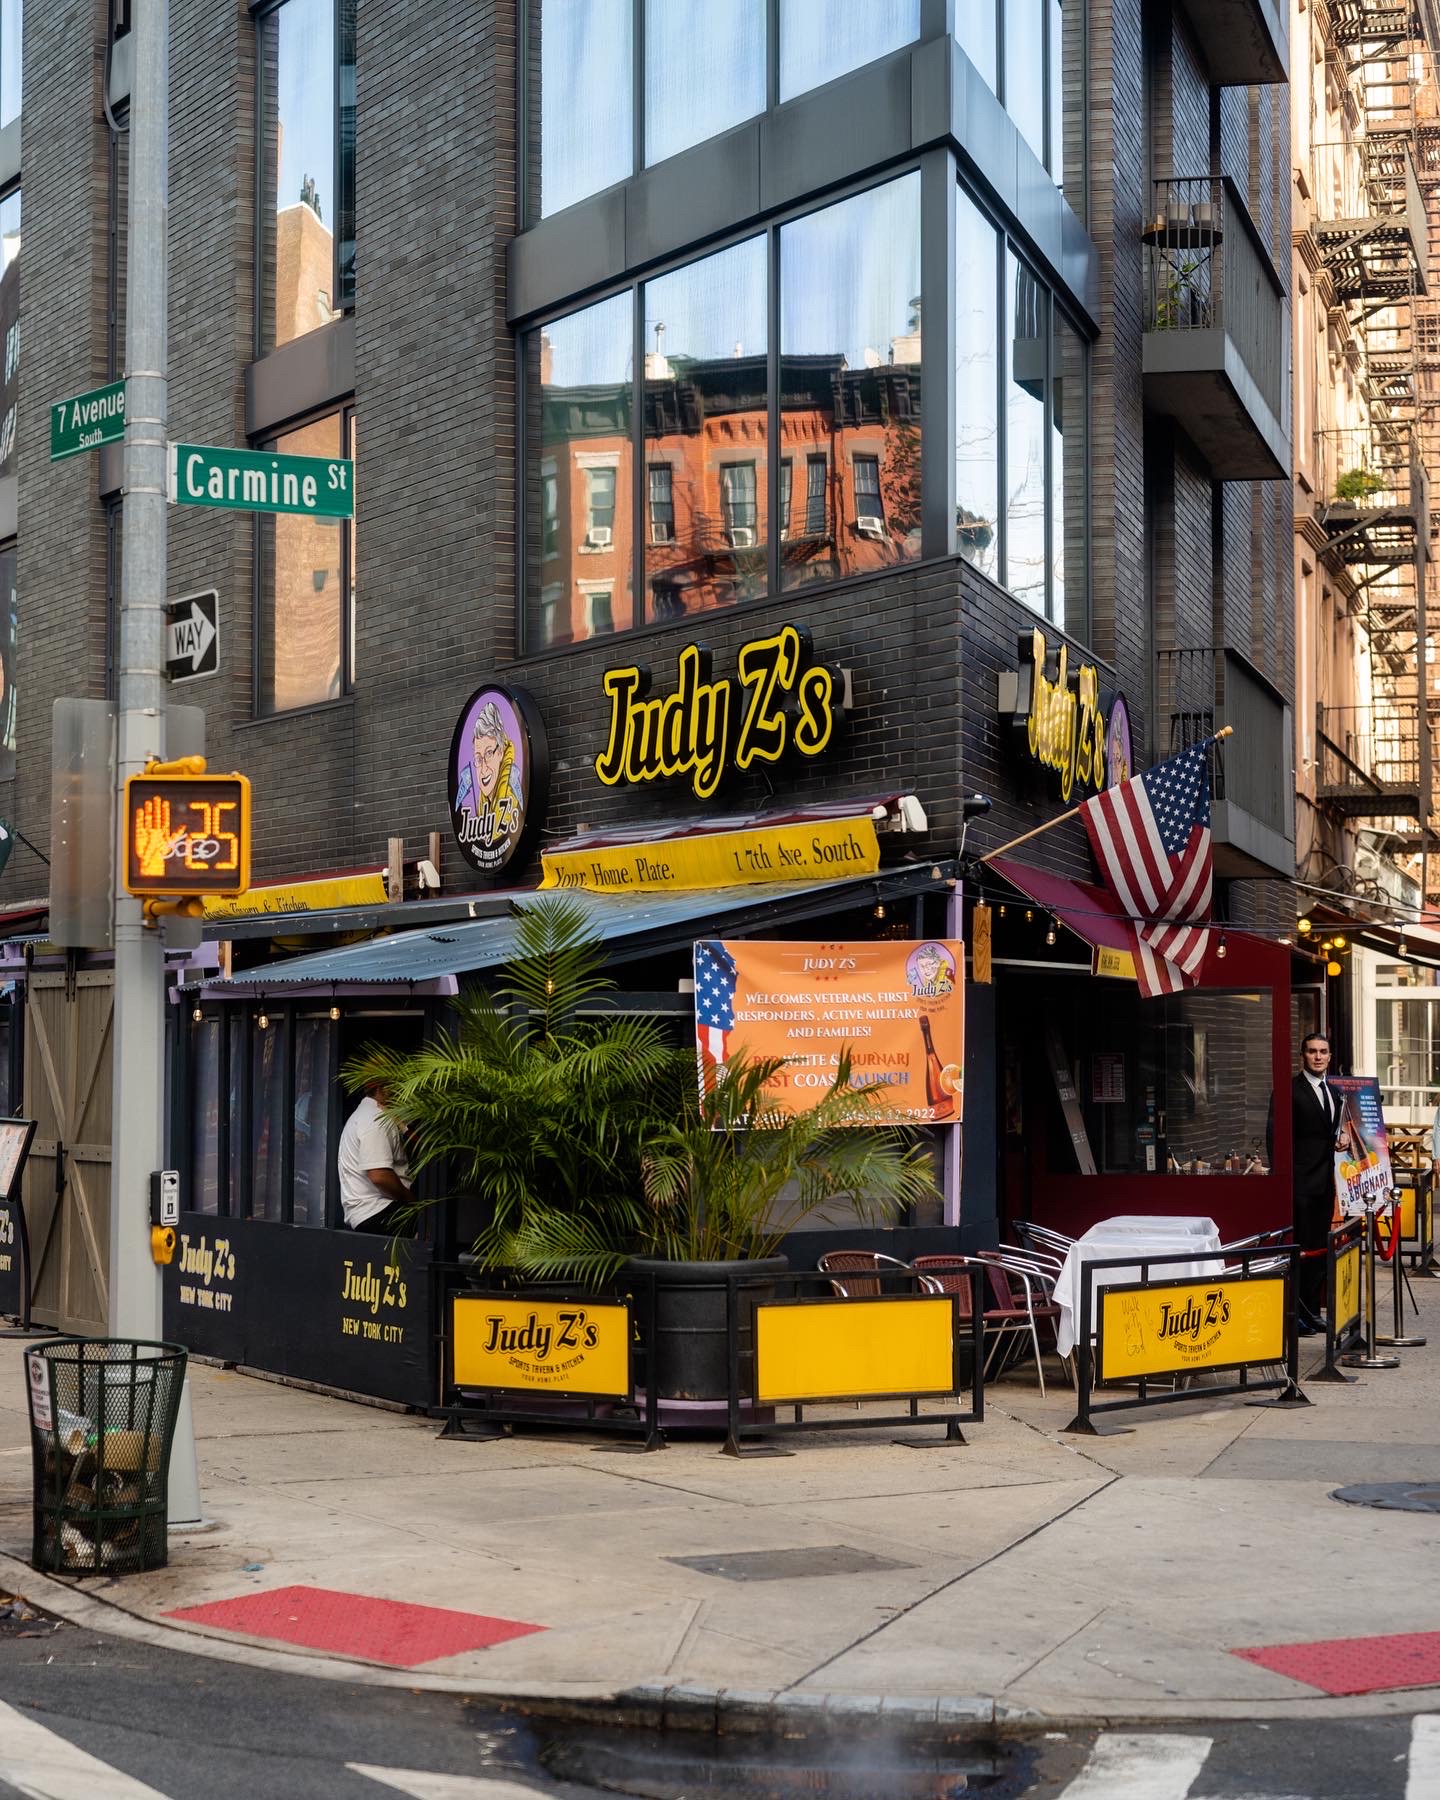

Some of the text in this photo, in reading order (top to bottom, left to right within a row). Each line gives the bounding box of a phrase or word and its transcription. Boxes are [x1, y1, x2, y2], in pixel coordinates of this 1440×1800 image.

[57, 391, 124, 433] 7 Avenue
[79, 428, 103, 448] South
[186, 454, 347, 508] Carmine St
[175, 620, 204, 655] WAY
[594, 625, 833, 799] Judy Z's
[459, 796, 519, 847] Judy Z's
[185, 802, 238, 870] 25
[778, 842, 807, 866] Ave.
[812, 834, 866, 864] South
[591, 863, 633, 886] Home.
[635, 858, 675, 882] Plate.
[803, 957, 856, 971] JUDY Z'S
[745, 993, 812, 1006] WELCOMES
[813, 992, 876, 1005] VETERANS,
[877, 991, 909, 1002] FIRST
[912, 981, 936, 998] Judy
[737, 1010, 815, 1022] RESPONDERS
[822, 1009, 863, 1021] ACTIVE
[865, 1008, 920, 1020] MILITARY
[787, 1026, 872, 1038] AND FAMILIES!
[829, 1053, 840, 1067] &
[179, 1235, 236, 1286] Judy Z's
[180, 1285, 232, 1312] NEW YORK CITY
[342, 1260, 407, 1314] Judy Z's
[1158, 1295, 1202, 1340] Judy
[1203, 1289, 1231, 1328] Z's
[342, 1317, 404, 1344] NEW YORK CITY
[484, 1310, 599, 1360] Judy Z's
[1174, 1340, 1187, 1353] SPORTS
[1188, 1344, 1203, 1354] TAVERN
[1206, 1330, 1222, 1350] KITCHEN
[508, 1353, 585, 1374] SPORTS TAVERN & KITCHEN
